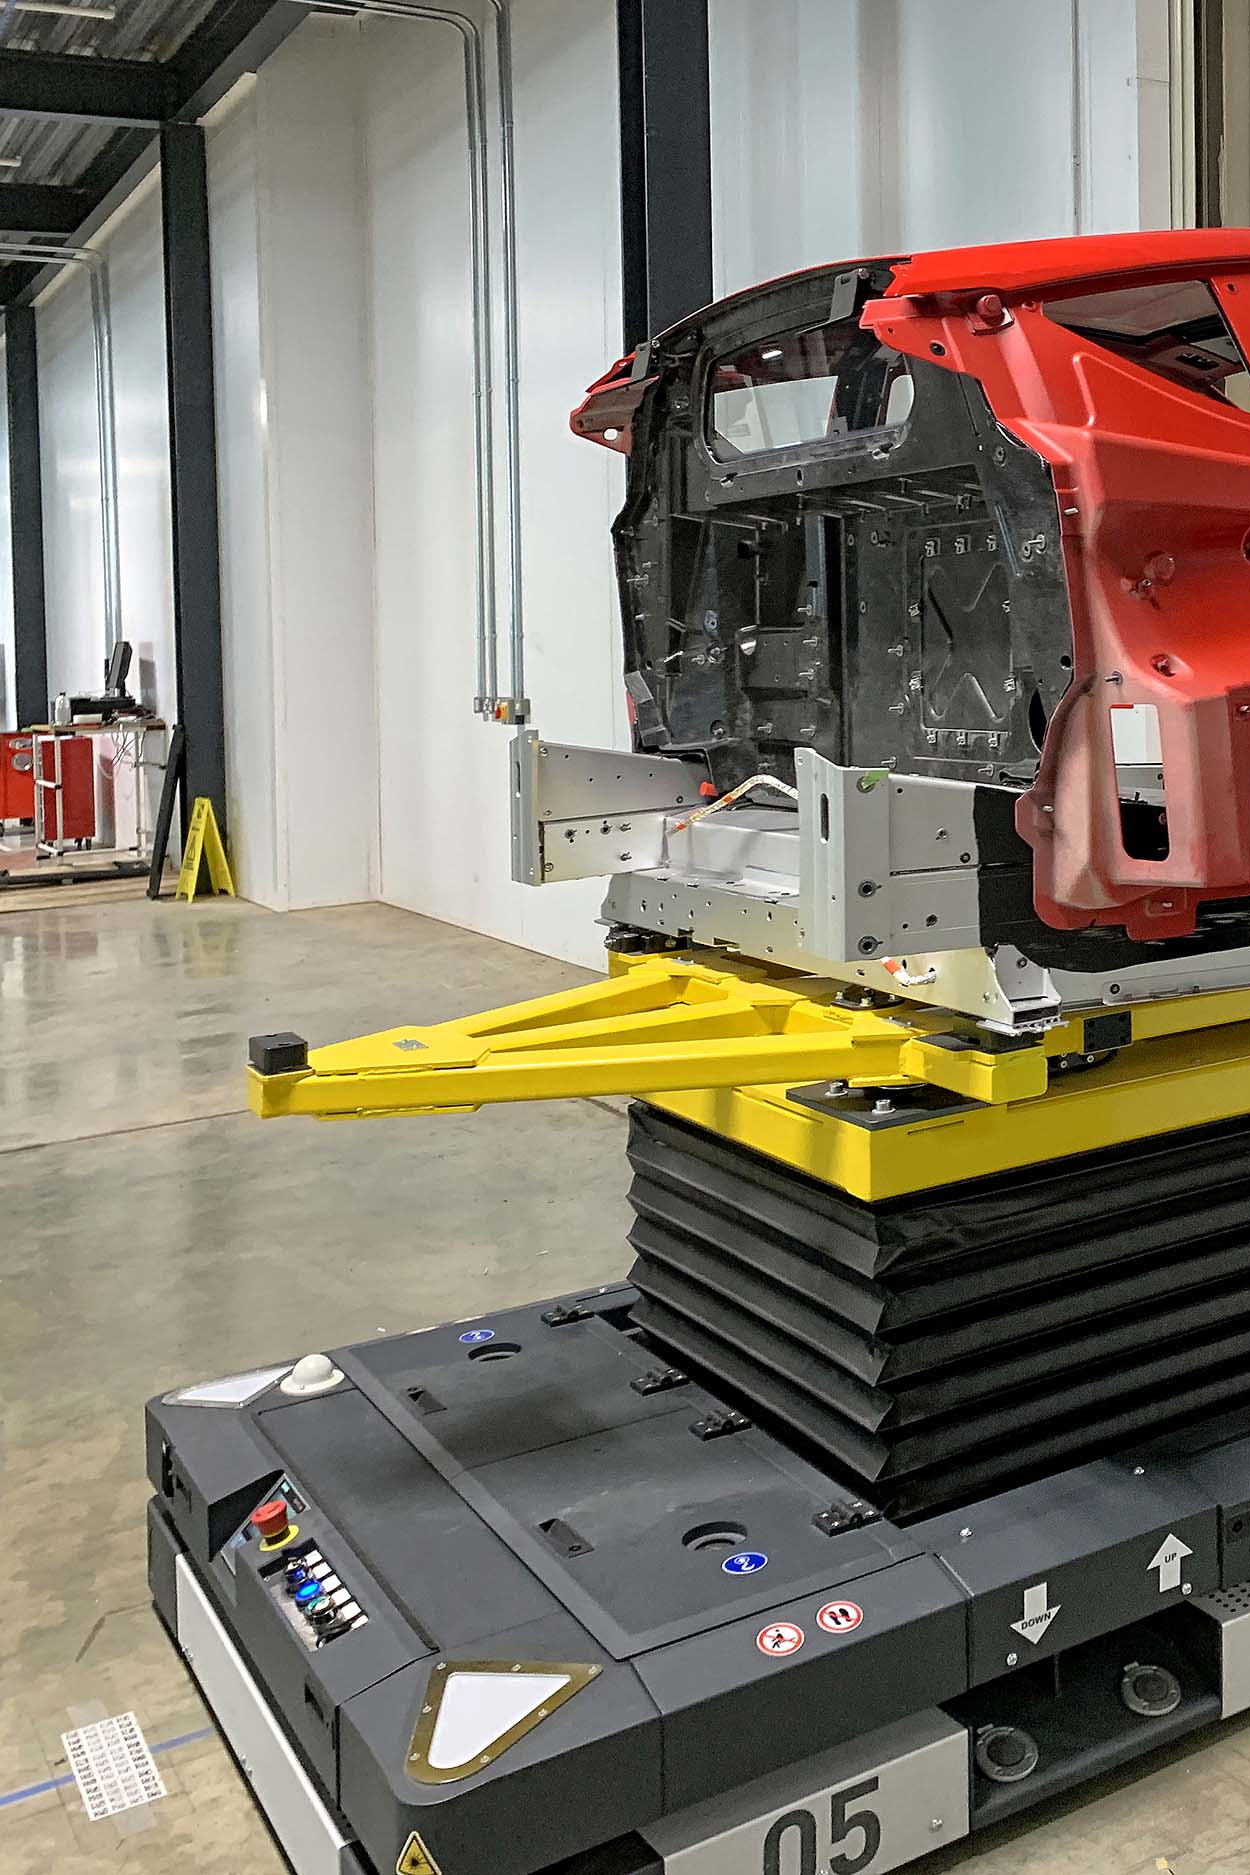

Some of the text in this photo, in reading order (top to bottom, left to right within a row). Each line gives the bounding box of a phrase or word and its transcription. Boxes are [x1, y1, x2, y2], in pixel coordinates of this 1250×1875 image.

[1164, 1552, 1177, 1564] UP
[1020, 1611, 1052, 1631] DOWN
[763, 1775, 881, 1875] 05
